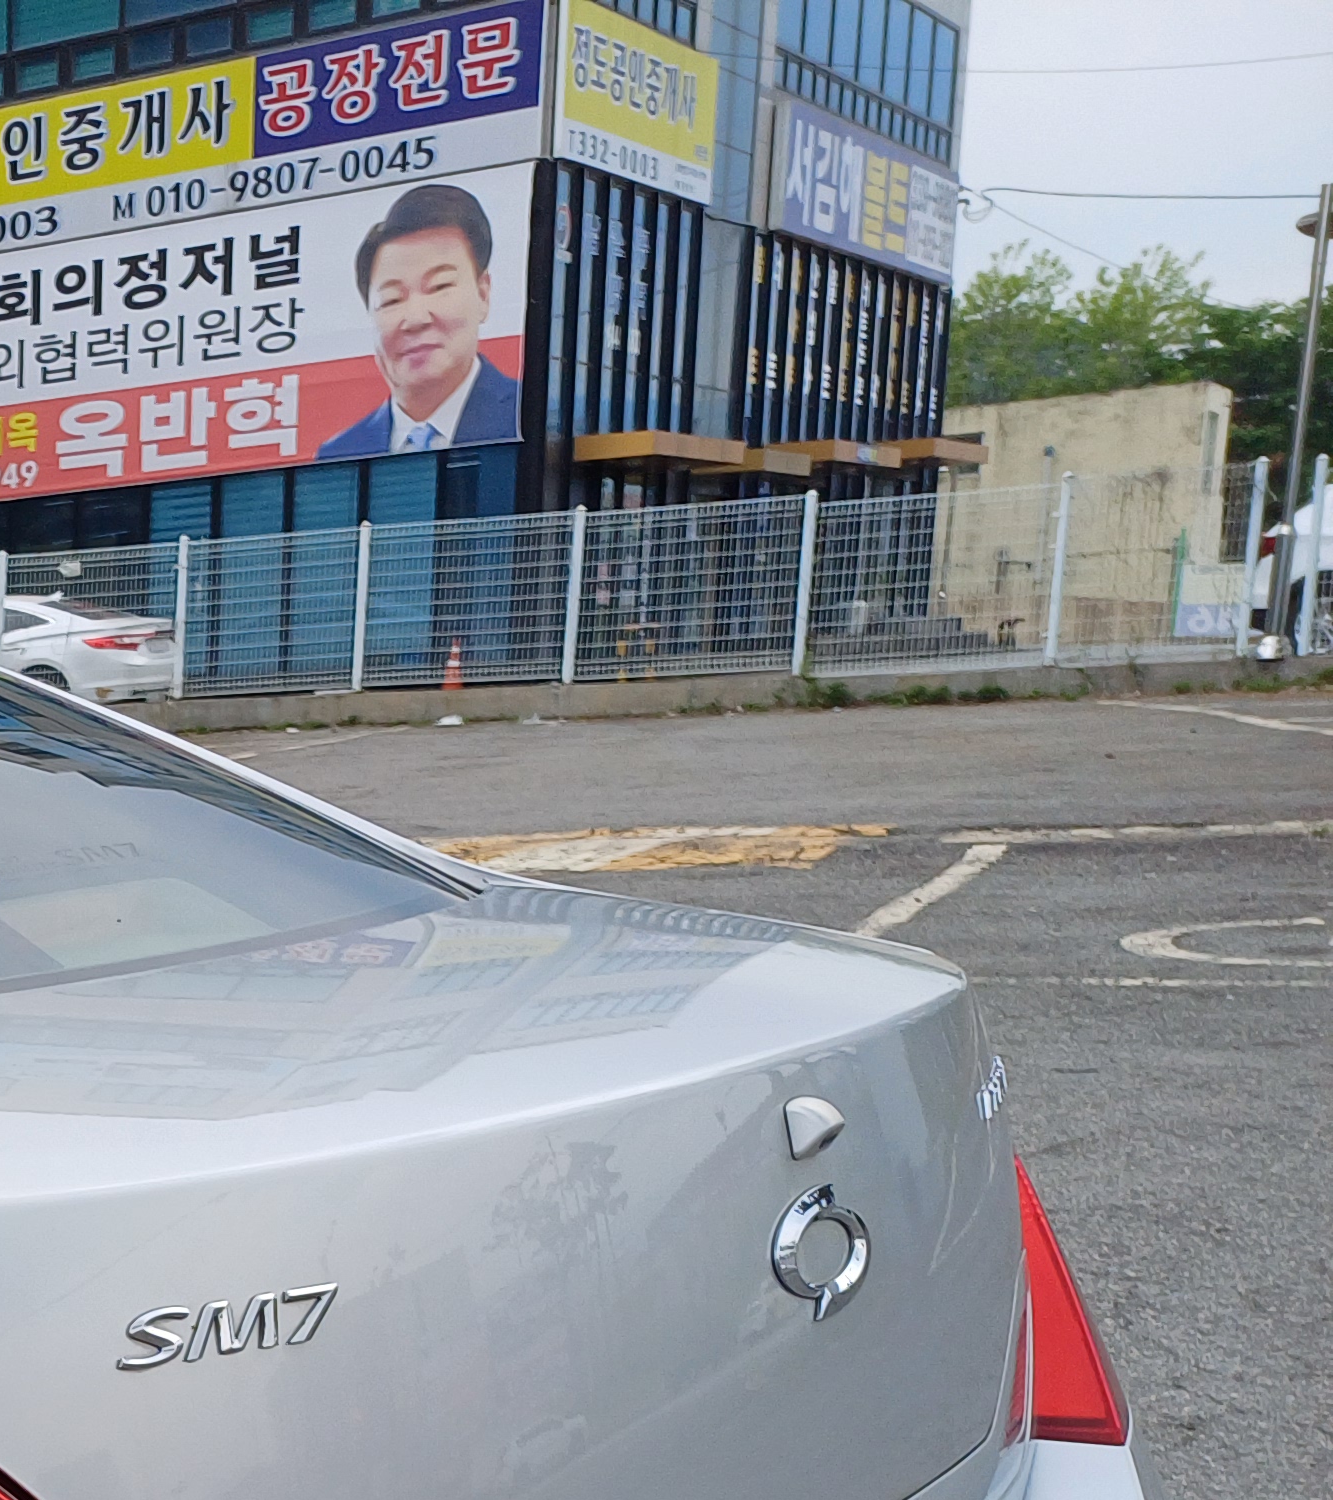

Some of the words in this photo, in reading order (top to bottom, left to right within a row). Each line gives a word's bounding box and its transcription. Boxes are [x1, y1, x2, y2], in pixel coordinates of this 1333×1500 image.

[260, 19, 519, 135] 공장전문
[571, 26, 697, 131] 정도공인중개사
[112, 192, 135, 222] M
[145, 135, 437, 218] 010-9807-0045
[55, 374, 300, 477] 옥반혁
[115, 1281, 339, 1371] SM7
